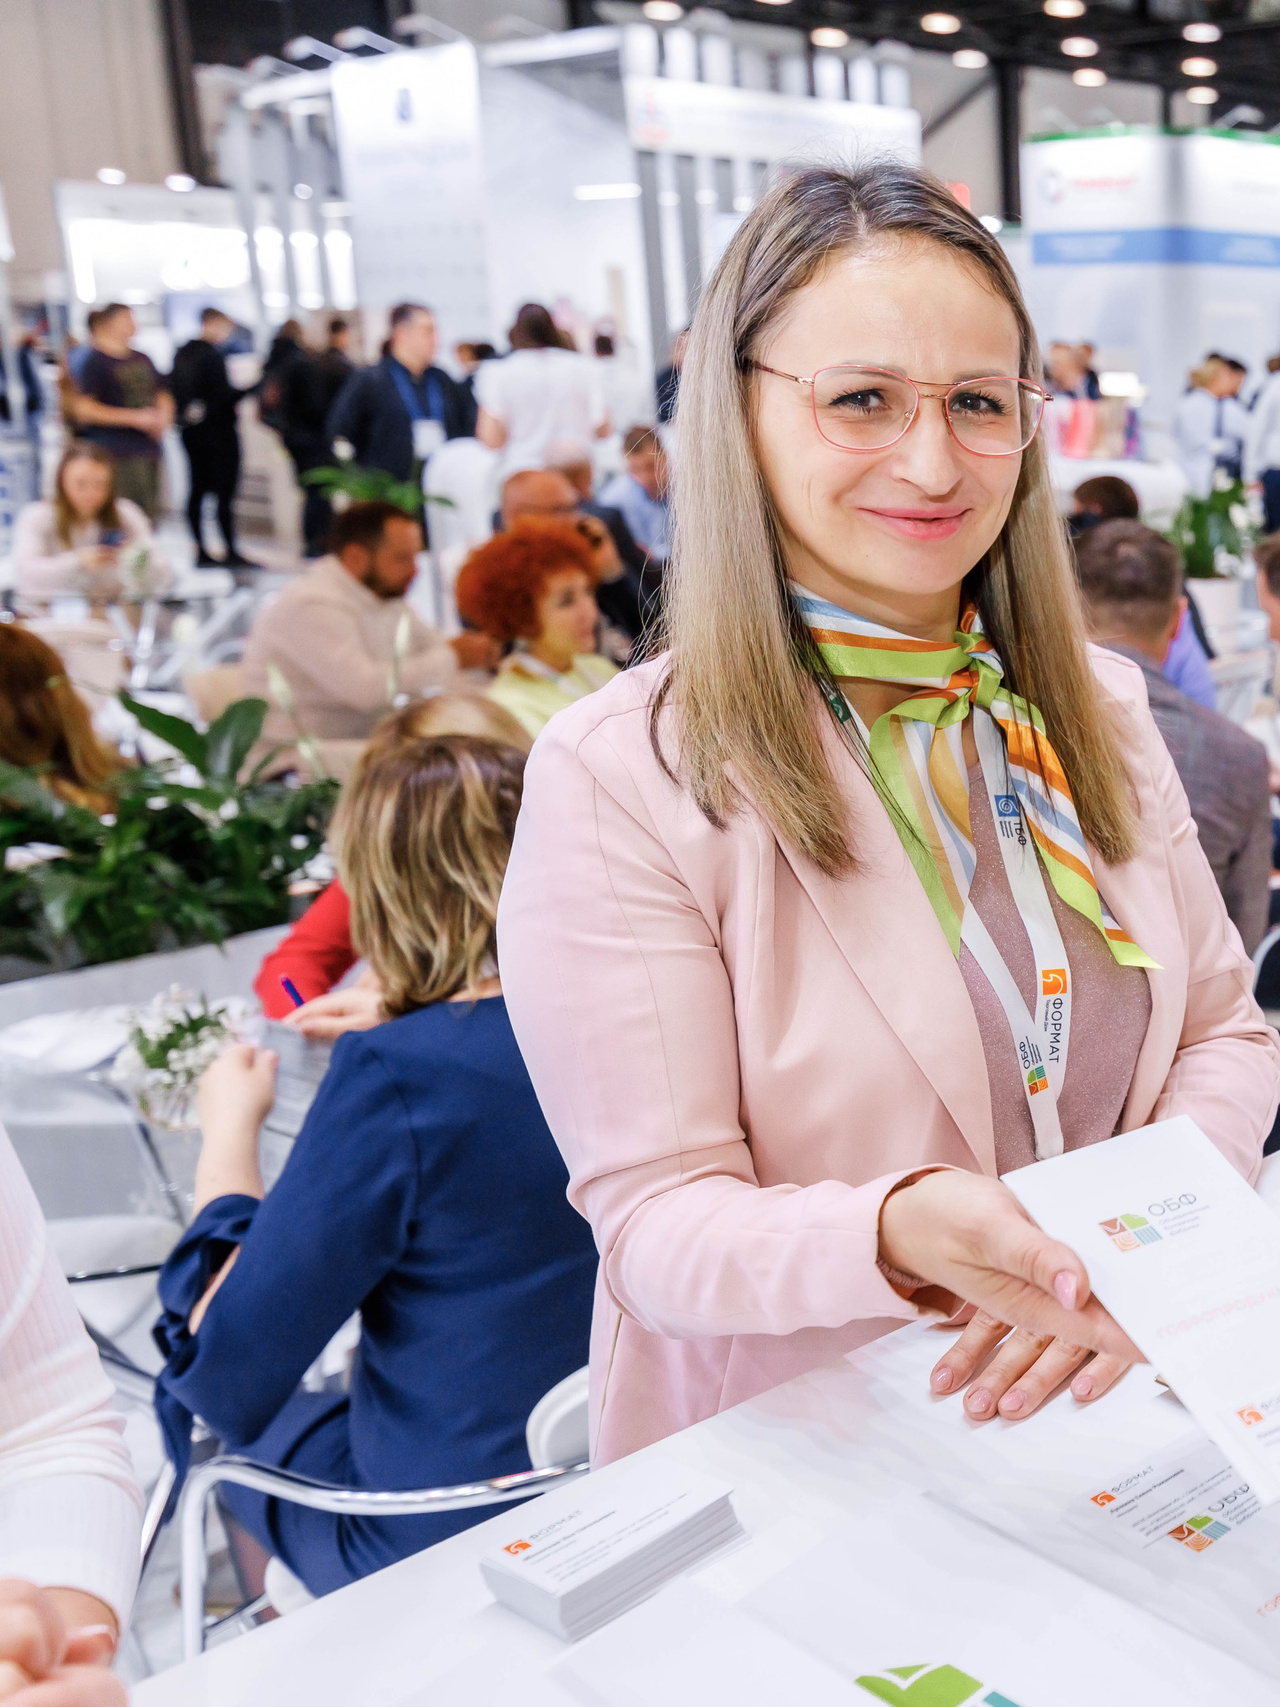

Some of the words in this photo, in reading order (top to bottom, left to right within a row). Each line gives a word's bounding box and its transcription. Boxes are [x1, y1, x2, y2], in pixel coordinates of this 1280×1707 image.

[1049, 997, 1064, 1063] ФОРМАТ
[1019, 1041, 1031, 1070] ОБФ
[1148, 1193, 1197, 1217] ОБФ
[1111, 1466, 1155, 1493] ФОРМАТ
